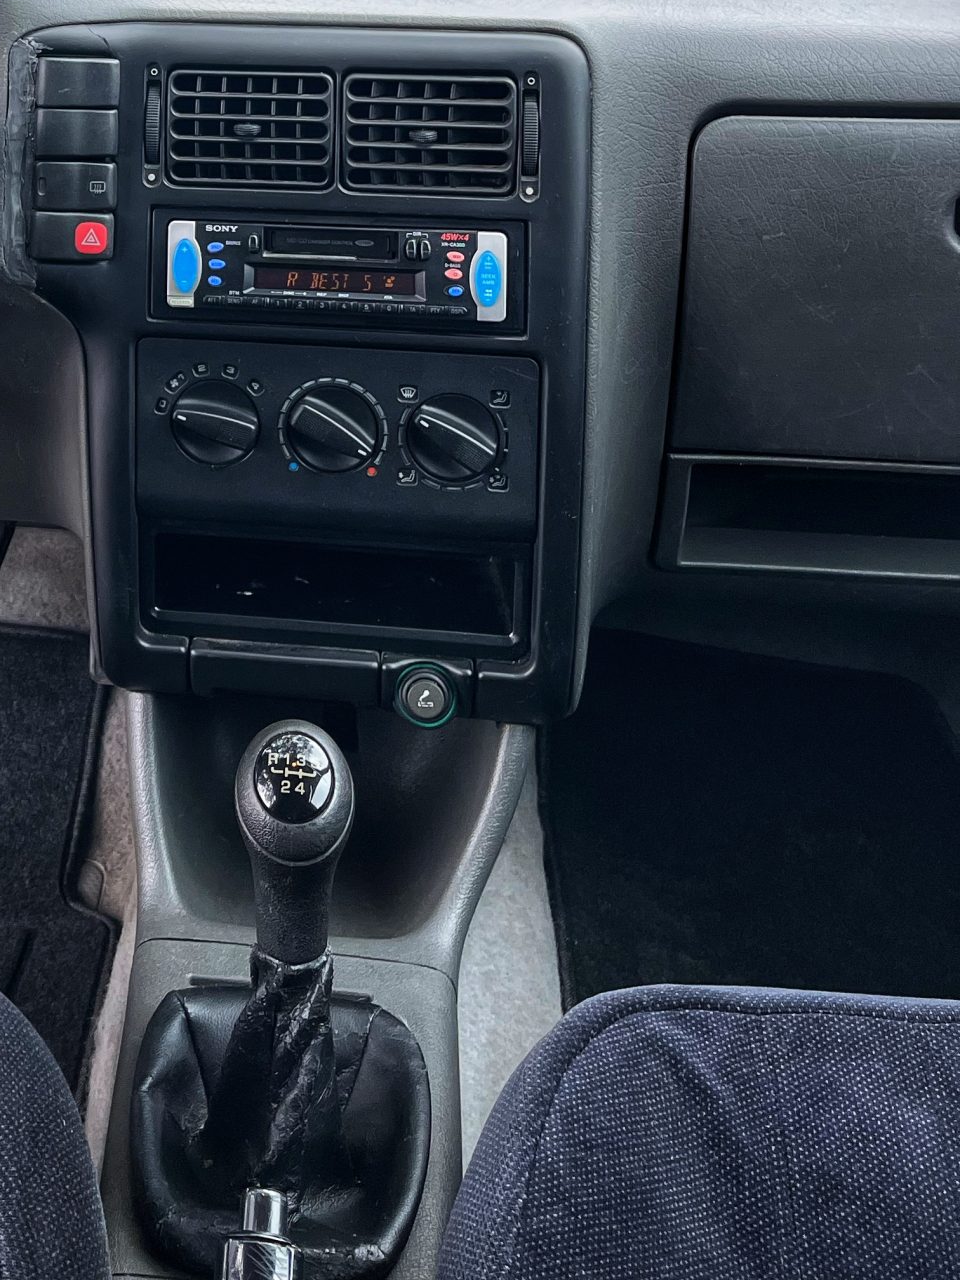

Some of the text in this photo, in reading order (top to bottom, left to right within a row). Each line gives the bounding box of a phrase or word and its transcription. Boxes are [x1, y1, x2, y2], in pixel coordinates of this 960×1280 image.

[205, 224, 238, 233] SONY
[310, 272, 350, 290] BEST
[296, 754, 306, 767] 3
[280, 780, 306, 795] 2 4
